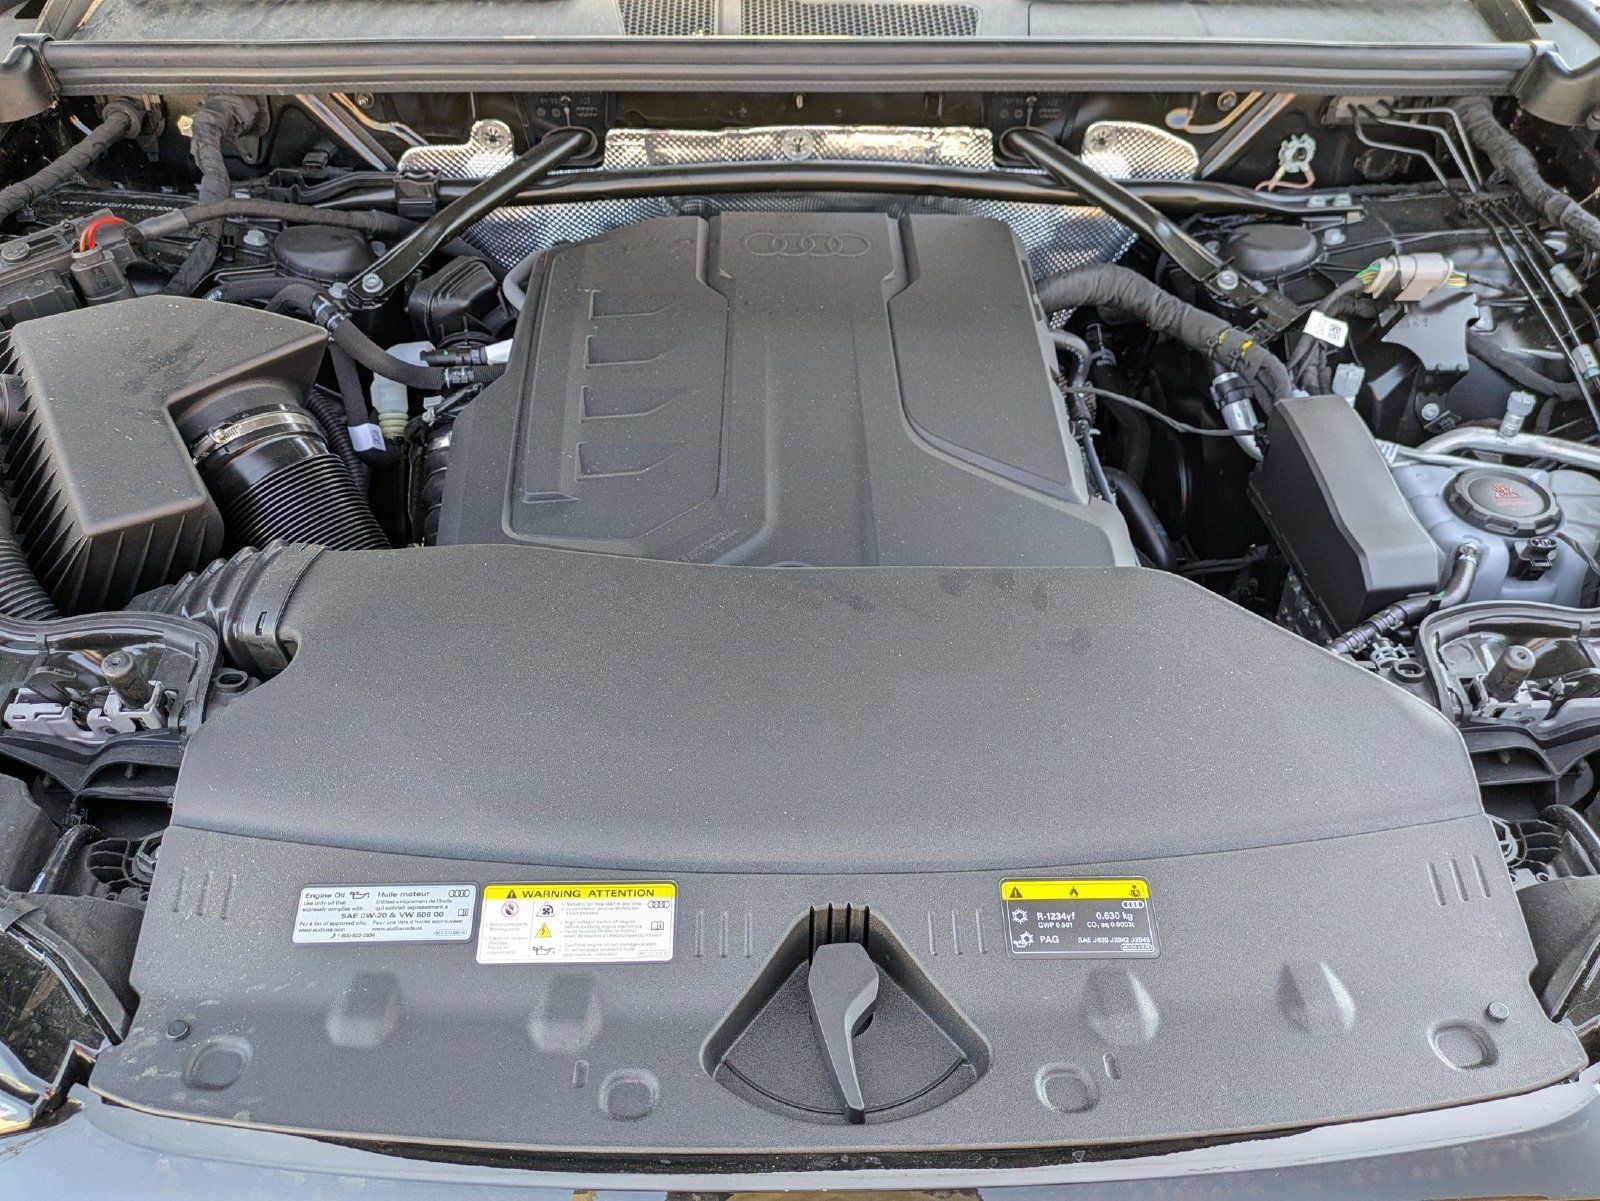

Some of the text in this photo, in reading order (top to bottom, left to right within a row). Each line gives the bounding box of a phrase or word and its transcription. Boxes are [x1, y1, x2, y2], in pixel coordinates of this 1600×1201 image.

[305, 892, 332, 900] Engine
[522, 889, 655, 898] WARNING ATTENTION
[1036, 911, 1075, 921] R-1234yf
[1095, 911, 1133, 921] 0.630 kg
[1040, 935, 1060, 943] PAG
